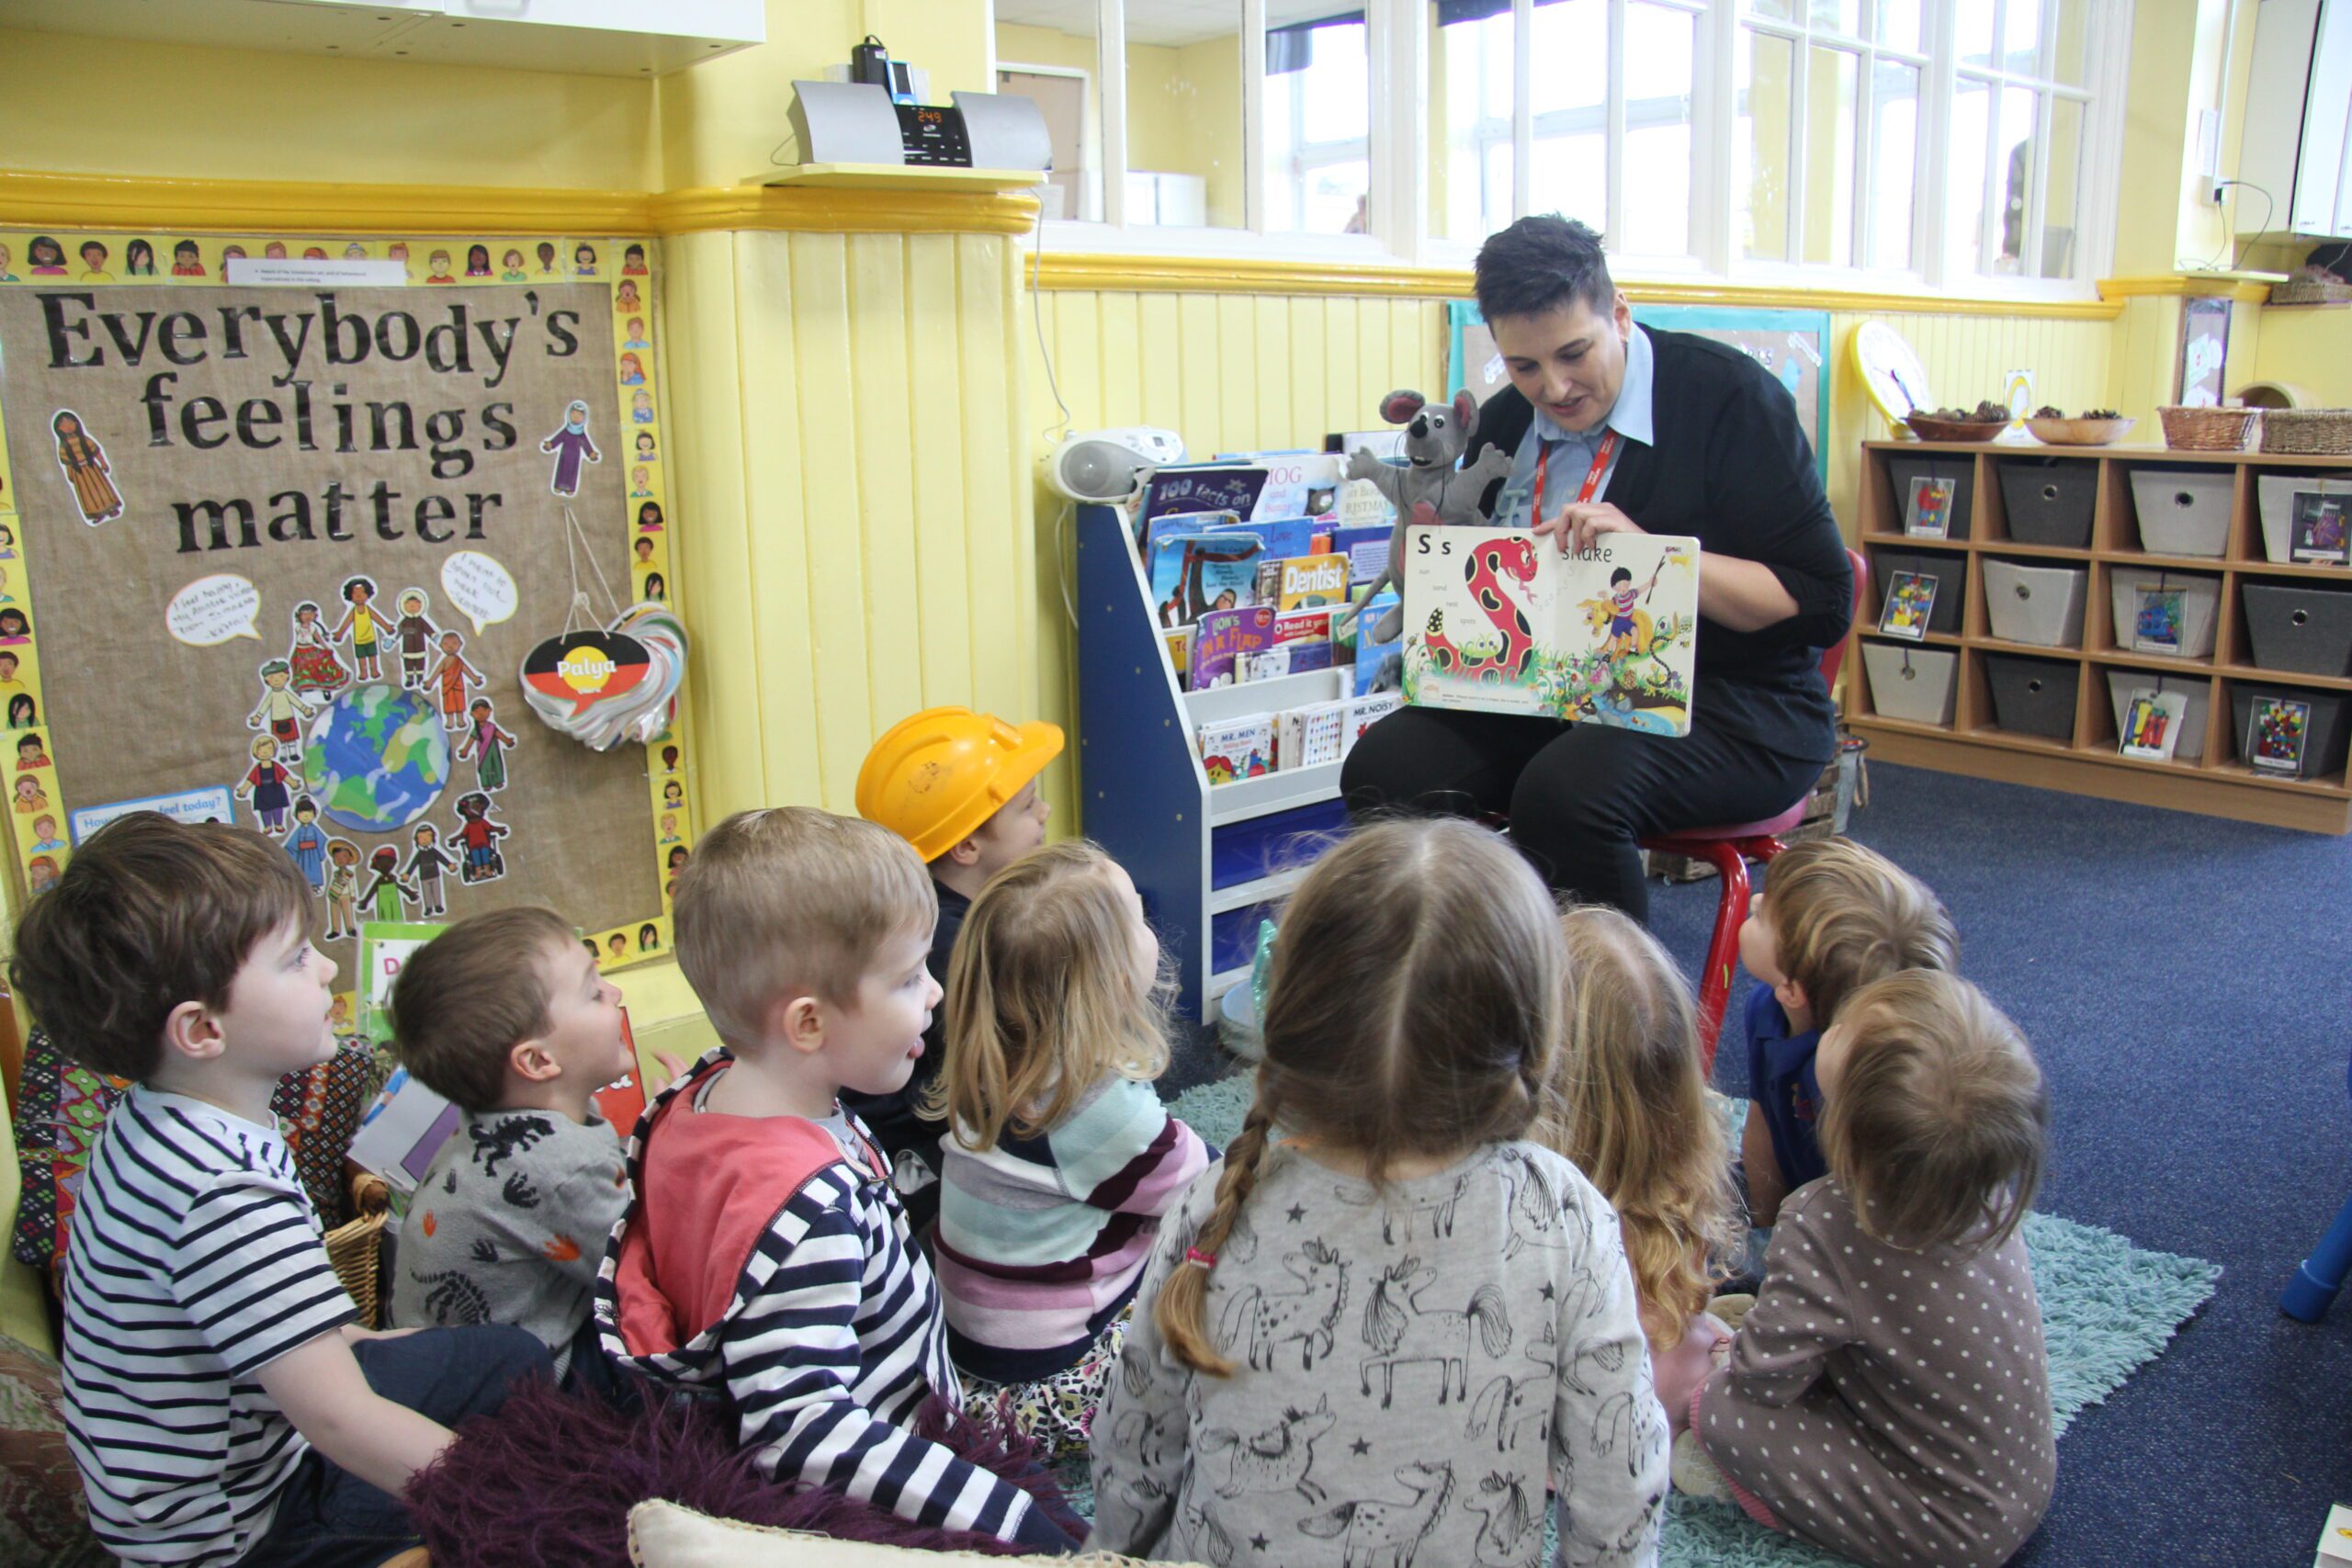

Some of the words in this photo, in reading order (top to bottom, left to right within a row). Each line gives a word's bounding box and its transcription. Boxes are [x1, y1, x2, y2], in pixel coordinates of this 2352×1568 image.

[35, 290, 581, 389] Everybody's
[140, 372, 517, 479] feelings
[1159, 479, 1193, 501] 100
[1195, 483, 1228, 505] facts
[1232, 492, 1251, 505] on
[171, 480, 503, 554] matter
[1418, 534, 1431, 554] S
[1442, 541, 1452, 555] s
[1284, 560, 1344, 594] Dentist
[1283, 619, 1305, 631] Read
[557, 658, 617, 679] Palya
[1369, 702, 1395, 714] NOISY
[1238, 728, 1256, 739] MEN
[159, 802, 180, 815] feel
[184, 795, 221, 814] today?
